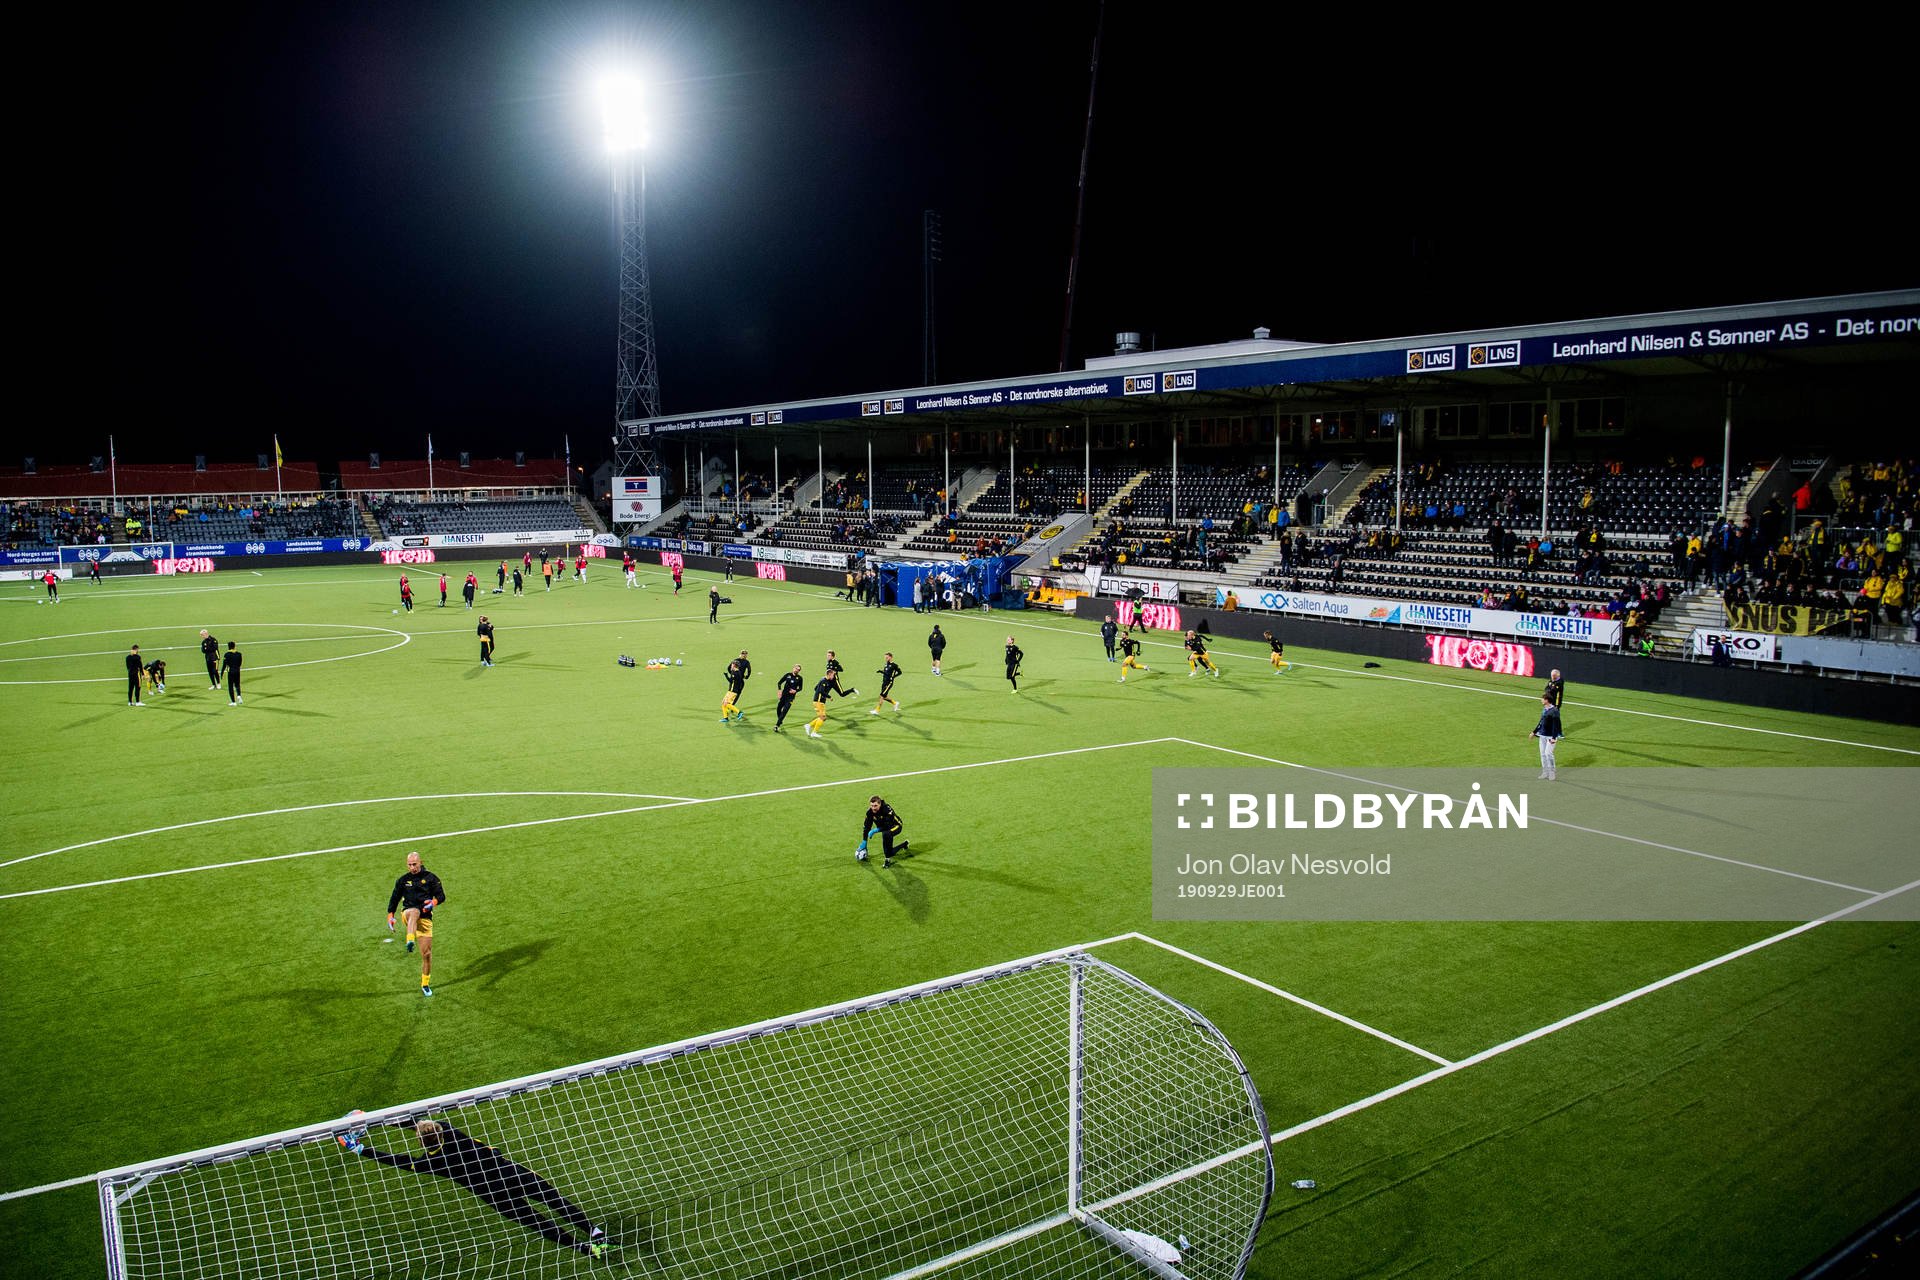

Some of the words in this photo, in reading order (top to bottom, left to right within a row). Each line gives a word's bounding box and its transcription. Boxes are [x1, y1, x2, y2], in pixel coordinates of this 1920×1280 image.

[1552, 336, 1627, 358] Leonhard
[1631, 333, 1684, 353] Nilsen
[1689, 331, 1704, 348] &
[1707, 328, 1775, 346] Sønner
[1779, 322, 1809, 342] AS
[1836, 318, 1875, 338] Det
[1427, 352, 1450, 366] LNS
[1490, 347, 1516, 361] LNS
[1136, 379, 1152, 390] LNS
[1176, 375, 1193, 387] LNS
[916, 398, 943, 410] Leonhard
[943, 397, 962, 408] Nilsen
[962, 395, 969, 405] &
[992, 392, 1003, 403] AS
[1009, 390, 1022, 401] Det
[1023, 387, 1063, 400] nordnorske
[1064, 383, 1108, 398] alternativet
[869, 403, 879, 412] LNS
[892, 401, 902, 410] LNS
[443, 534, 484, 543] HANESETH
[1292, 597, 1321, 612] Salten
[1324, 600, 1349, 615] Aqua
[1407, 604, 1472, 624] HANESETH
[1517, 614, 1592, 635] HANESETH
[1526, 629, 1588, 641] ELEKTROENTREPRENØR
